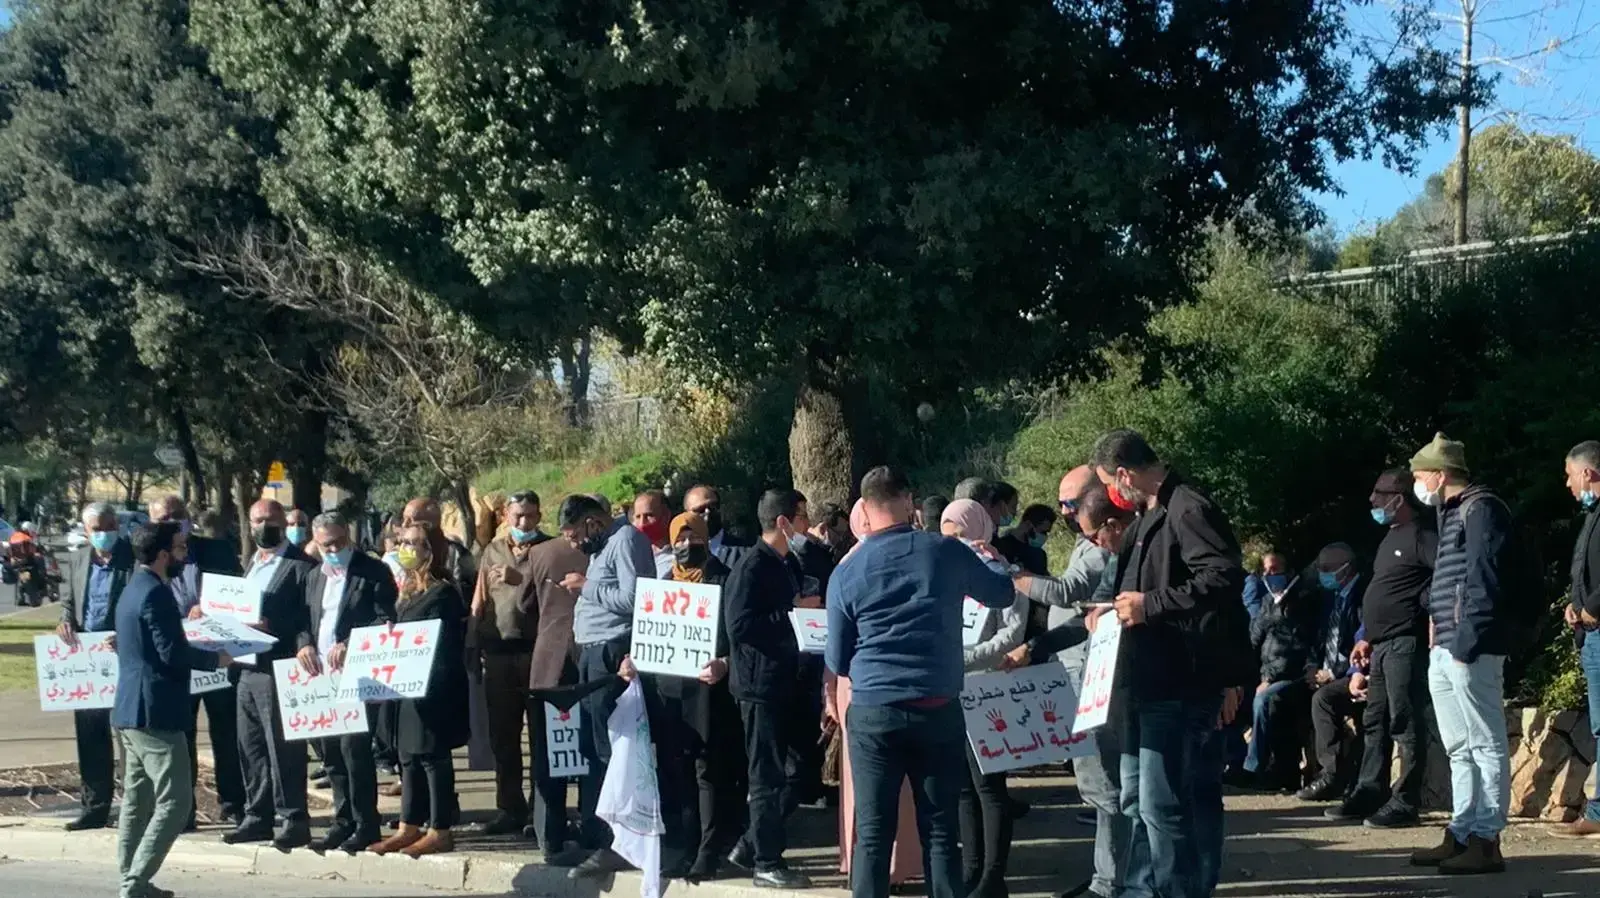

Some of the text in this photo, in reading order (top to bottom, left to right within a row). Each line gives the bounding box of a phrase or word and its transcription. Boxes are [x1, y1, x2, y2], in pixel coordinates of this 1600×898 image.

[662, 588, 691, 616] לא
[379, 630, 404, 649] די
[637, 617, 711, 642] באנו לעולם
[633, 642, 675, 664] למות
[193, 670, 227, 689] לטבח
[371, 664, 397, 684] די
[288, 707, 360, 732] دم اليهودي
[1016, 704, 1032, 728] في
[977, 731, 1045, 760] السياسة
